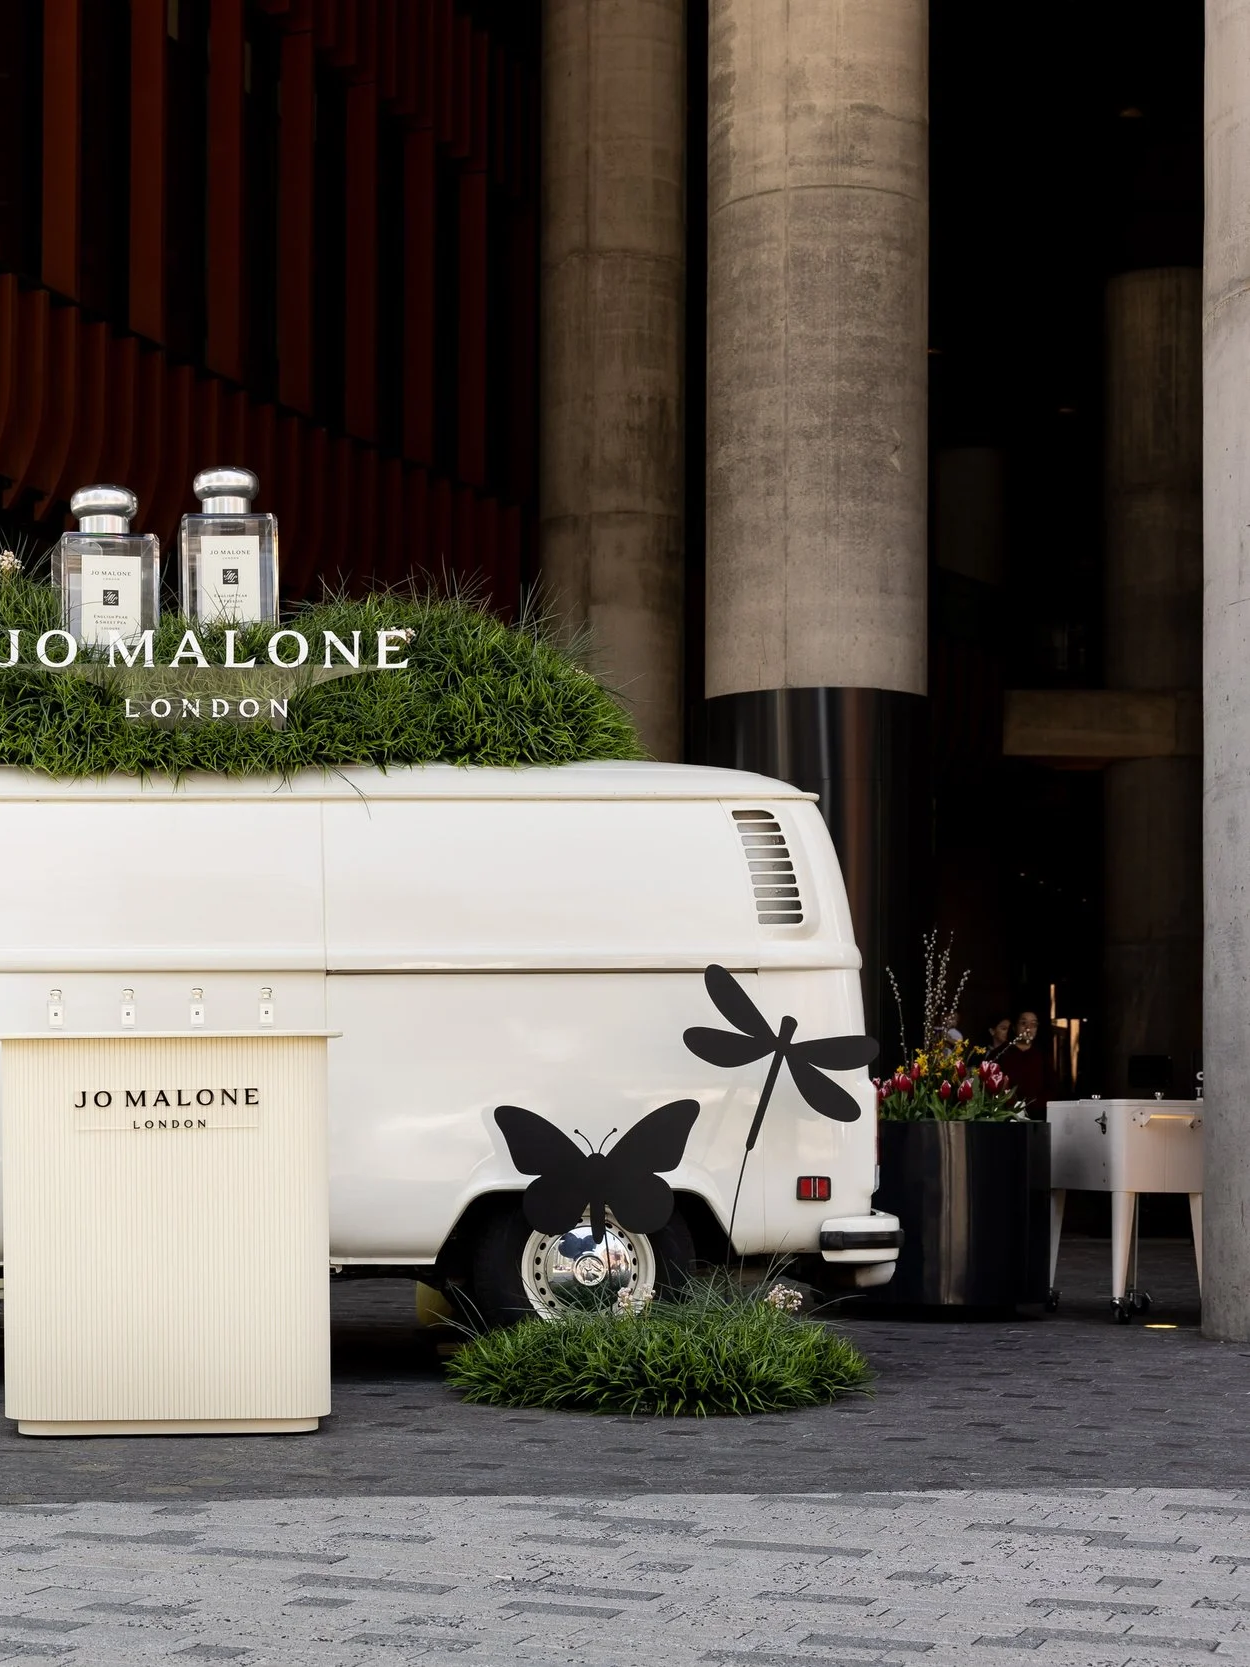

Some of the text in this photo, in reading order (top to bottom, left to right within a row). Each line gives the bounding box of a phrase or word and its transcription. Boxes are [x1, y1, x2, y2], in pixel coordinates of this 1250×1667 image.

[107, 629, 409, 669] MALONE
[125, 698, 289, 719] LONDON
[75, 1088, 259, 1109] JO MALONE
[133, 1119, 207, 1130] LONDON
